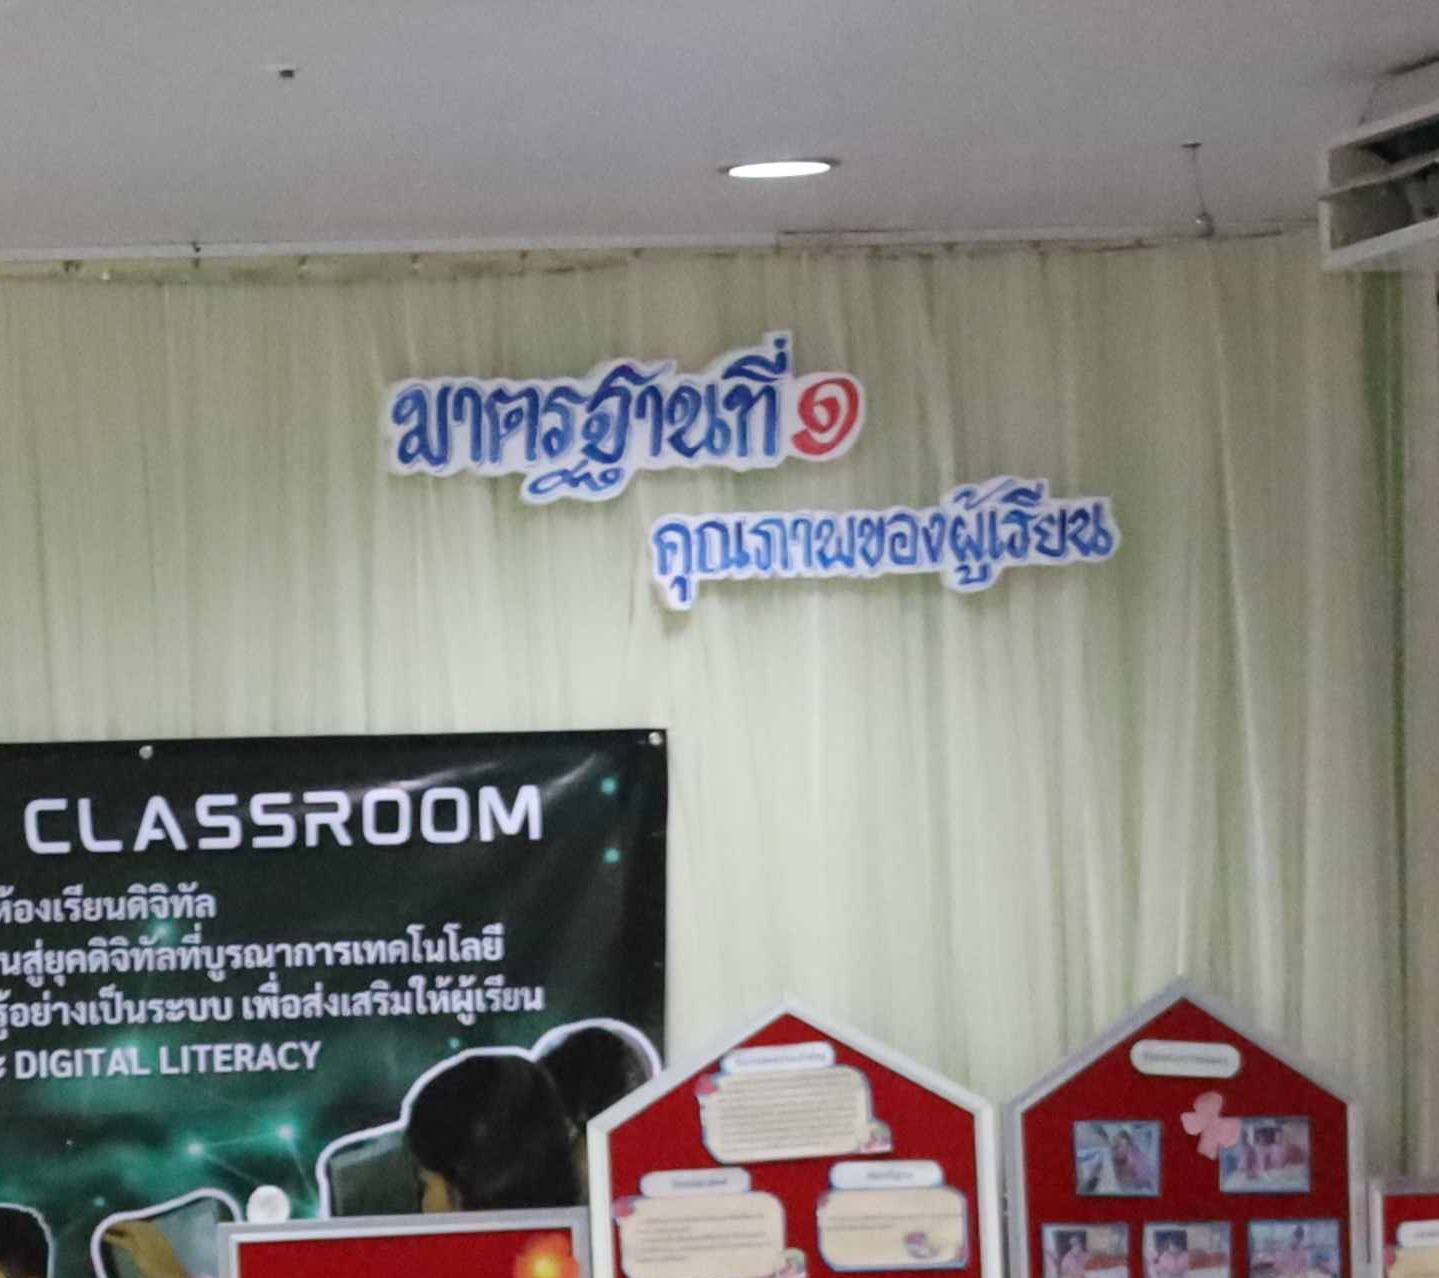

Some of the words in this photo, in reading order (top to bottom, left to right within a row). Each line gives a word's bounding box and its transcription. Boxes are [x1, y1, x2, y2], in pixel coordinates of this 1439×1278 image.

[390, 336, 794, 496] มาตรฐานที่
[654, 478, 1116, 604] คุณภาพของผู้เรียน
[24, 784, 544, 855] CLASSROOM
[242, 972, 546, 1026] เพื่อส่งเสริมให้ผู้เรียน
[14, 1045, 151, 1080] DIGITAL
[159, 1040, 323, 1075] LITERACY
